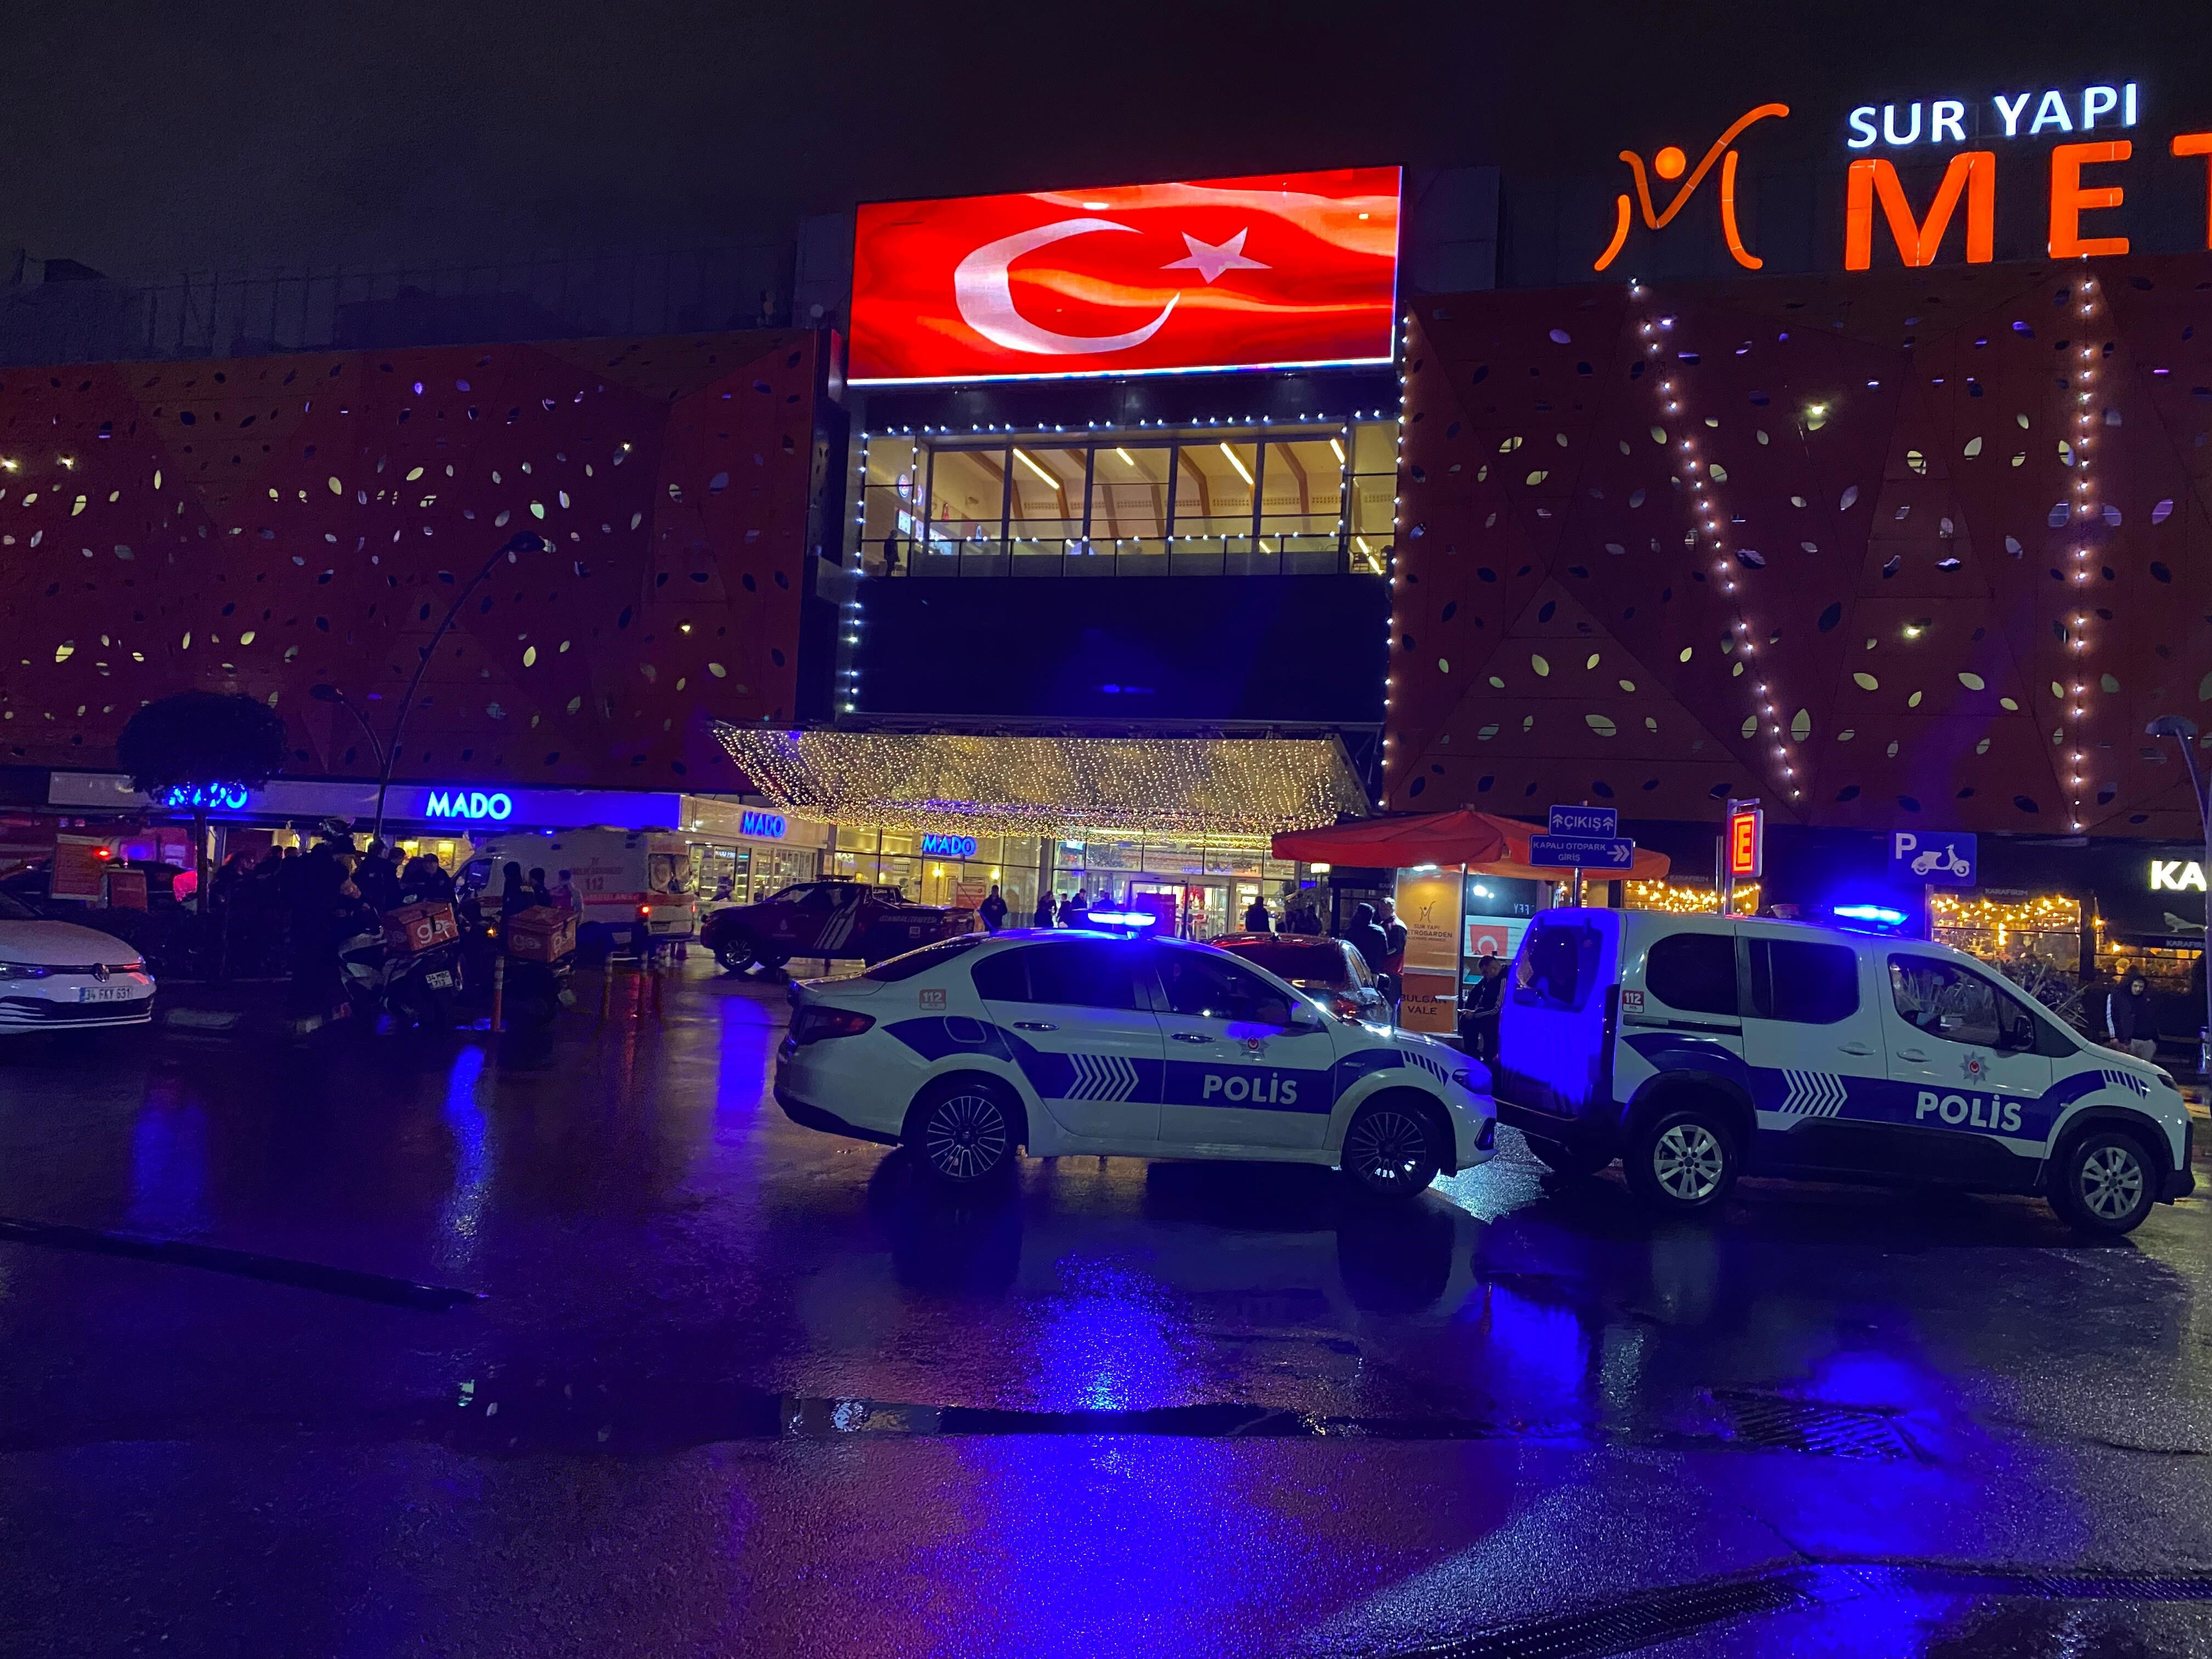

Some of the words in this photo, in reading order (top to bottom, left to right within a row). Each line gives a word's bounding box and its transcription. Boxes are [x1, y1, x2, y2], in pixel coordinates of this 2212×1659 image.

[1847, 99, 1966, 148] SUR
[1993, 81, 2137, 137] YAPI
[426, 791, 512, 820] MADO
[742, 811, 785, 838] MADO
[1564, 815, 1601, 831] ÇIKIŞ
[923, 833, 975, 856] MADO
[1533, 841, 1564, 850] KAPALI
[1566, 843, 1606, 851] OTOPARK
[1737, 824, 1751, 864] E
[1895, 833, 1917, 859] P
[1558, 853, 1581, 862] GİRİŞ
[586, 877, 604, 890] 112
[2150, 859, 2207, 891] KA
[1407, 929, 1452, 938] TROGARDEN
[86, 990, 95, 1000] 34
[99, 989, 114, 999] FKY
[117, 988, 130, 998] 631
[923, 991, 941, 1002] 112
[1625, 992, 1641, 1004] 112
[1408, 1006, 1437, 1014] VALE
[1203, 1073, 1297, 1104] POLİS
[1916, 1094, 2022, 1132] POLİS
